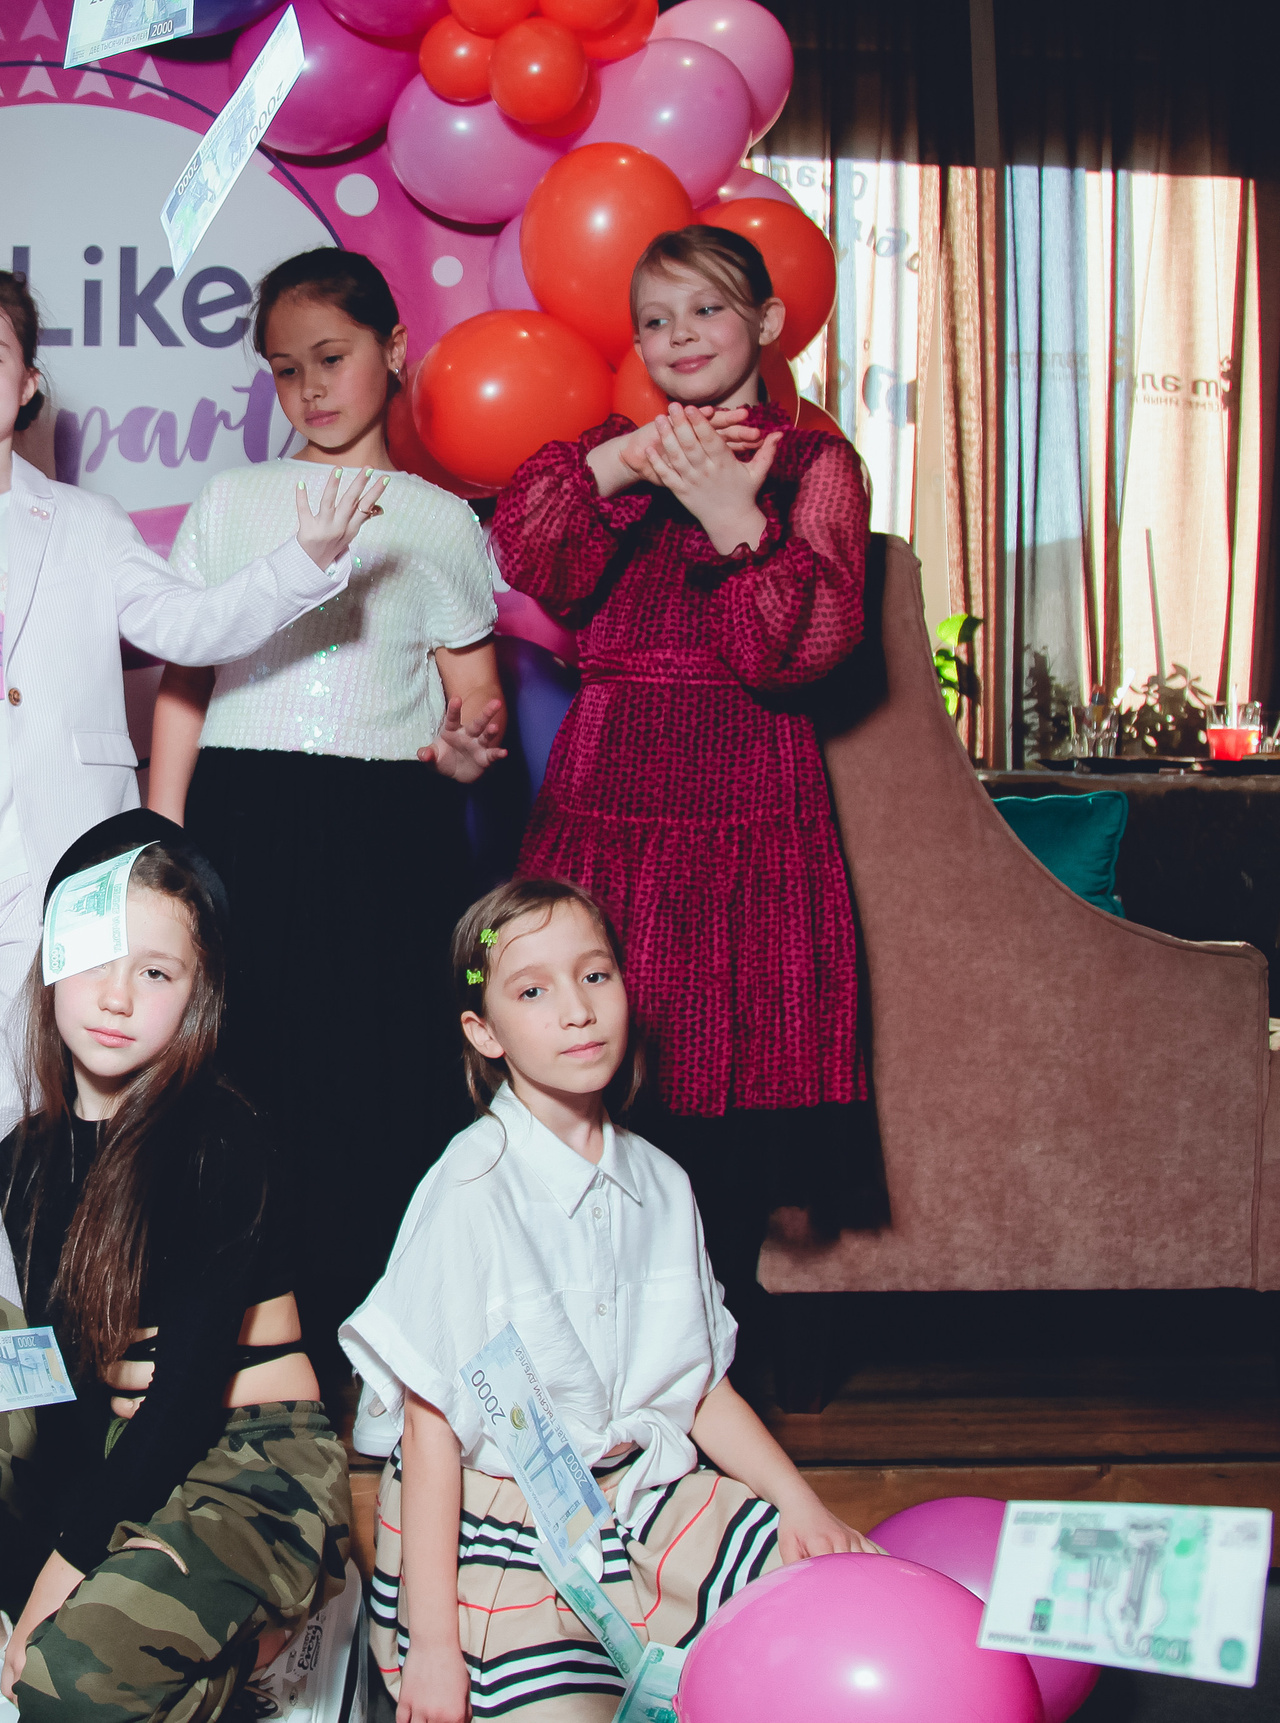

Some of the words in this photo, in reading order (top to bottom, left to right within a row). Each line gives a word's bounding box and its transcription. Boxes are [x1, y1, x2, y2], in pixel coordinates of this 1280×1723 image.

[151, 20, 173, 37] 2000
[248, 78, 285, 146] 2000
[177, 157, 198, 196] 2000
[12, 244, 253, 348] Like
[54, 368, 297, 486] part
[50, 947, 58, 971] 1000
[16, 1336, 36, 1347] 2000
[468, 1367, 506, 1427] 2000
[532, 1383, 556, 1424] ТЫСЯЧИ
[554, 1423, 568, 1445] ДВЕ
[565, 1451, 587, 1489] 2000
[598, 1632, 632, 1676] 1000
